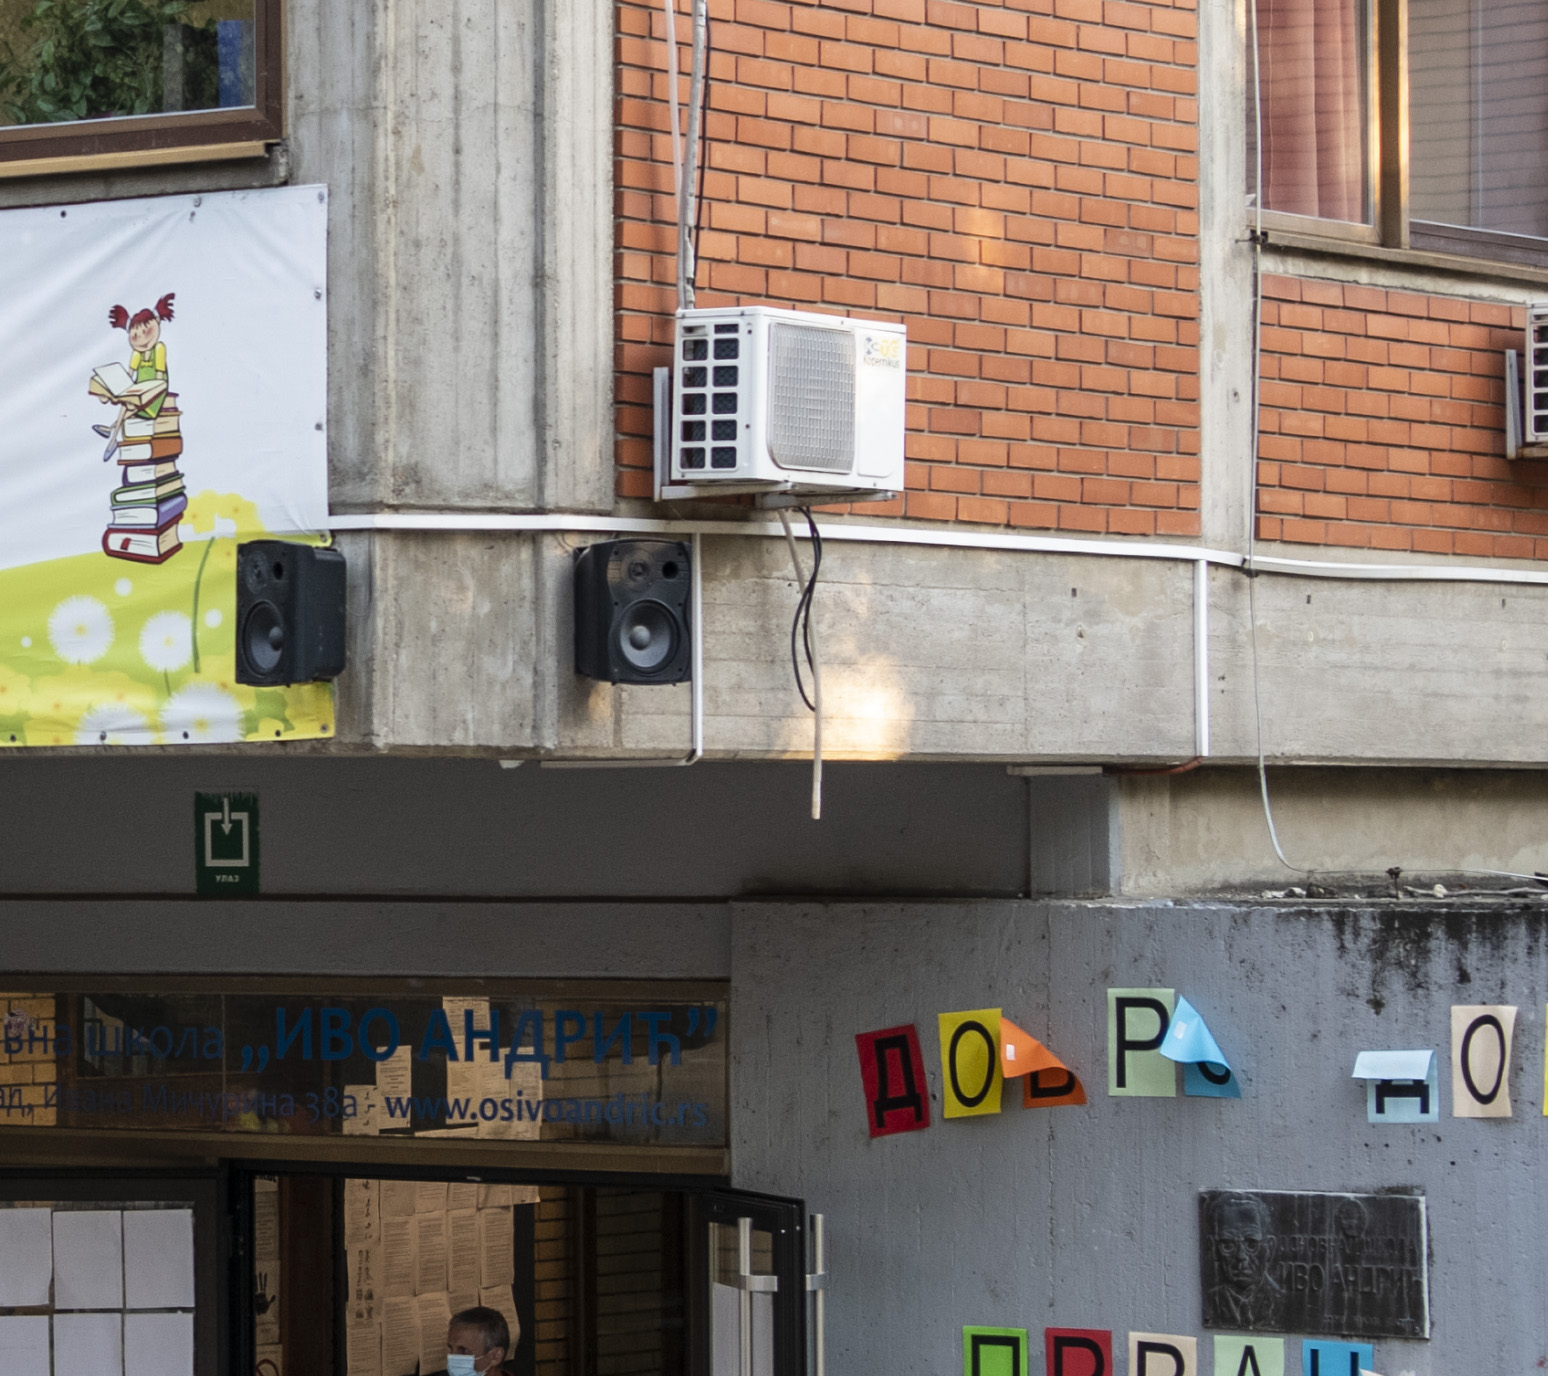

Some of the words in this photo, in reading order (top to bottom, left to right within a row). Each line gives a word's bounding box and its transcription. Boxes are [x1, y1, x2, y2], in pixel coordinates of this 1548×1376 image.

[215, 874, 240, 883] УЛАЗ
[88, 1025, 224, 1059] школа
[874, 996, 1232, 1129] ДОР
[141, 1084, 295, 1122] Мичурина
[306, 1086, 358, 1122] 38а
[384, 1090, 708, 1127] www.osivoandric.rs
